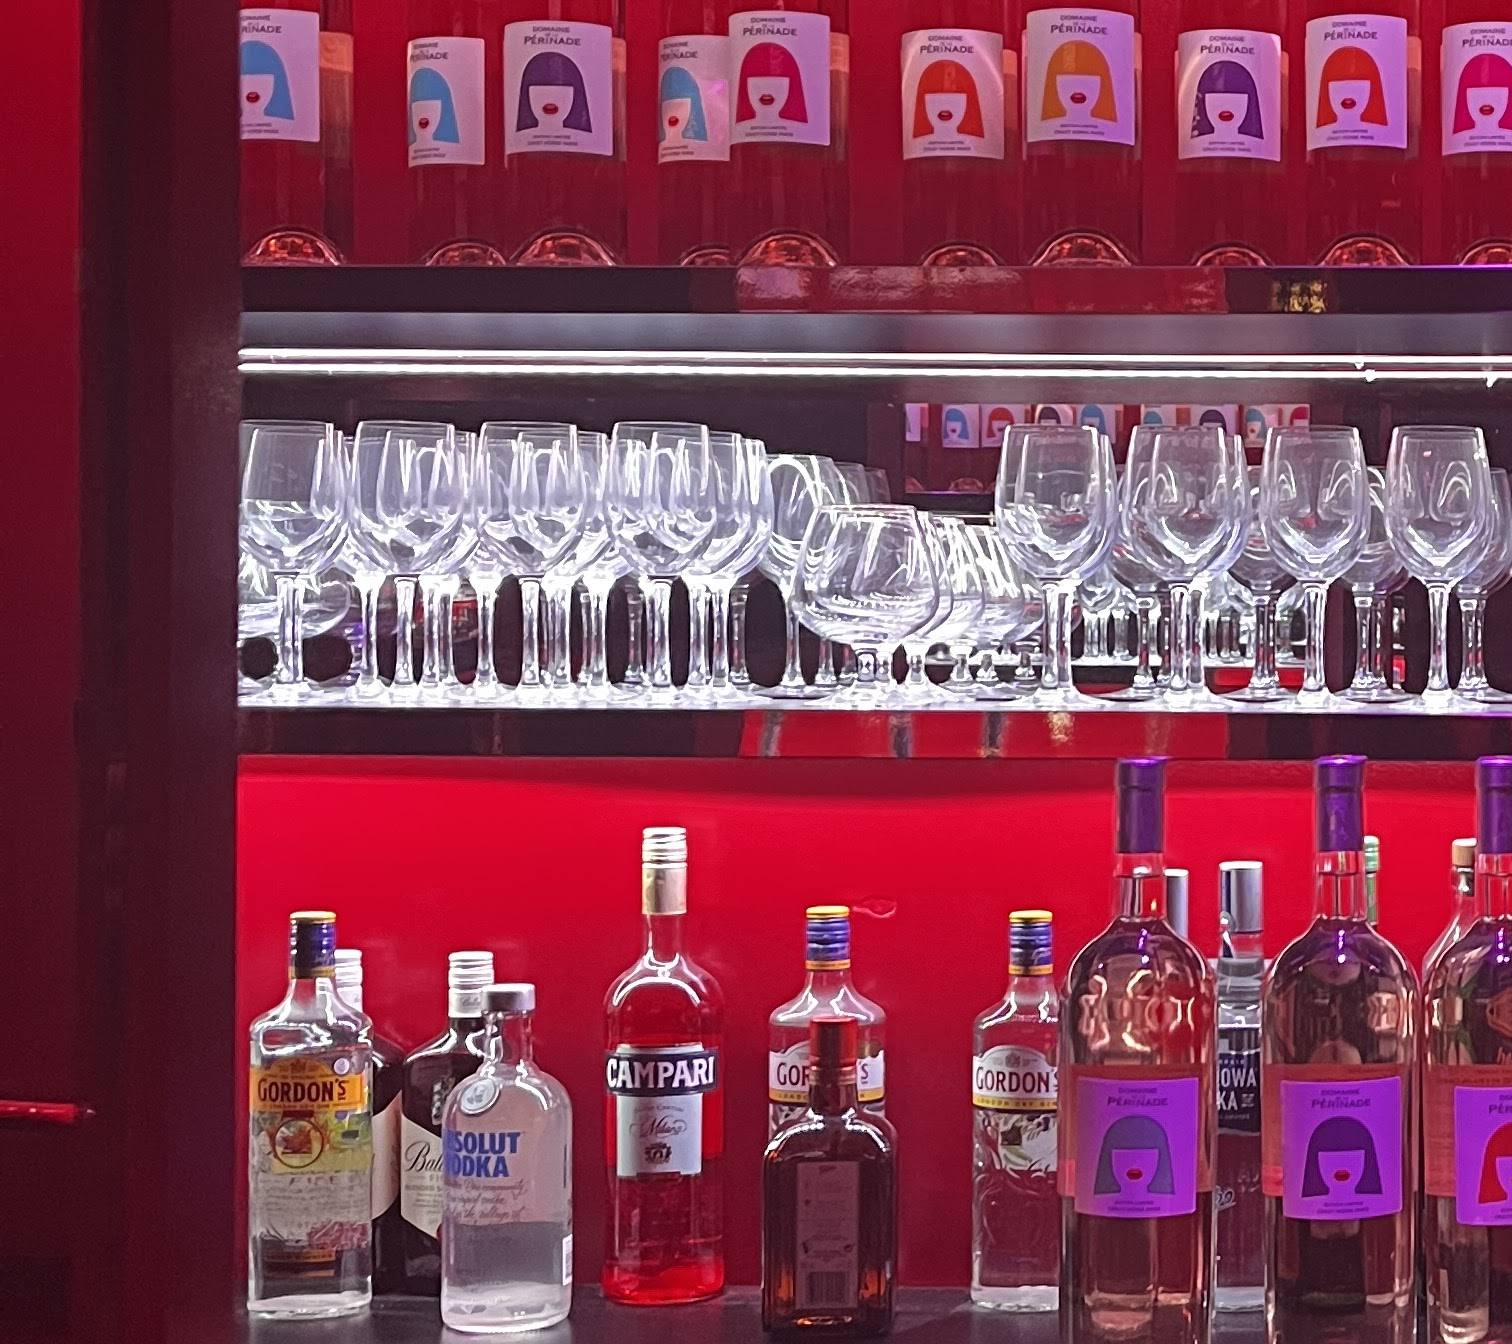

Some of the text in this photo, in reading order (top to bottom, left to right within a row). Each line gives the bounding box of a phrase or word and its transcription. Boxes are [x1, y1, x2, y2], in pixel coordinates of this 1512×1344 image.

[743, 25, 797, 36] PÉRINADE
[1050, 23, 1108, 35] PÉRINADE
[1324, 29, 1378, 41] PÉRINADE
[524, 34, 581, 46] PÉRINADE
[920, 43, 974, 54] PÉRINADE
[1200, 43, 1255, 55] PÉRINADE
[607, 1056, 715, 1088] CAMPARI
[258, 1078, 346, 1103] GORDON'S
